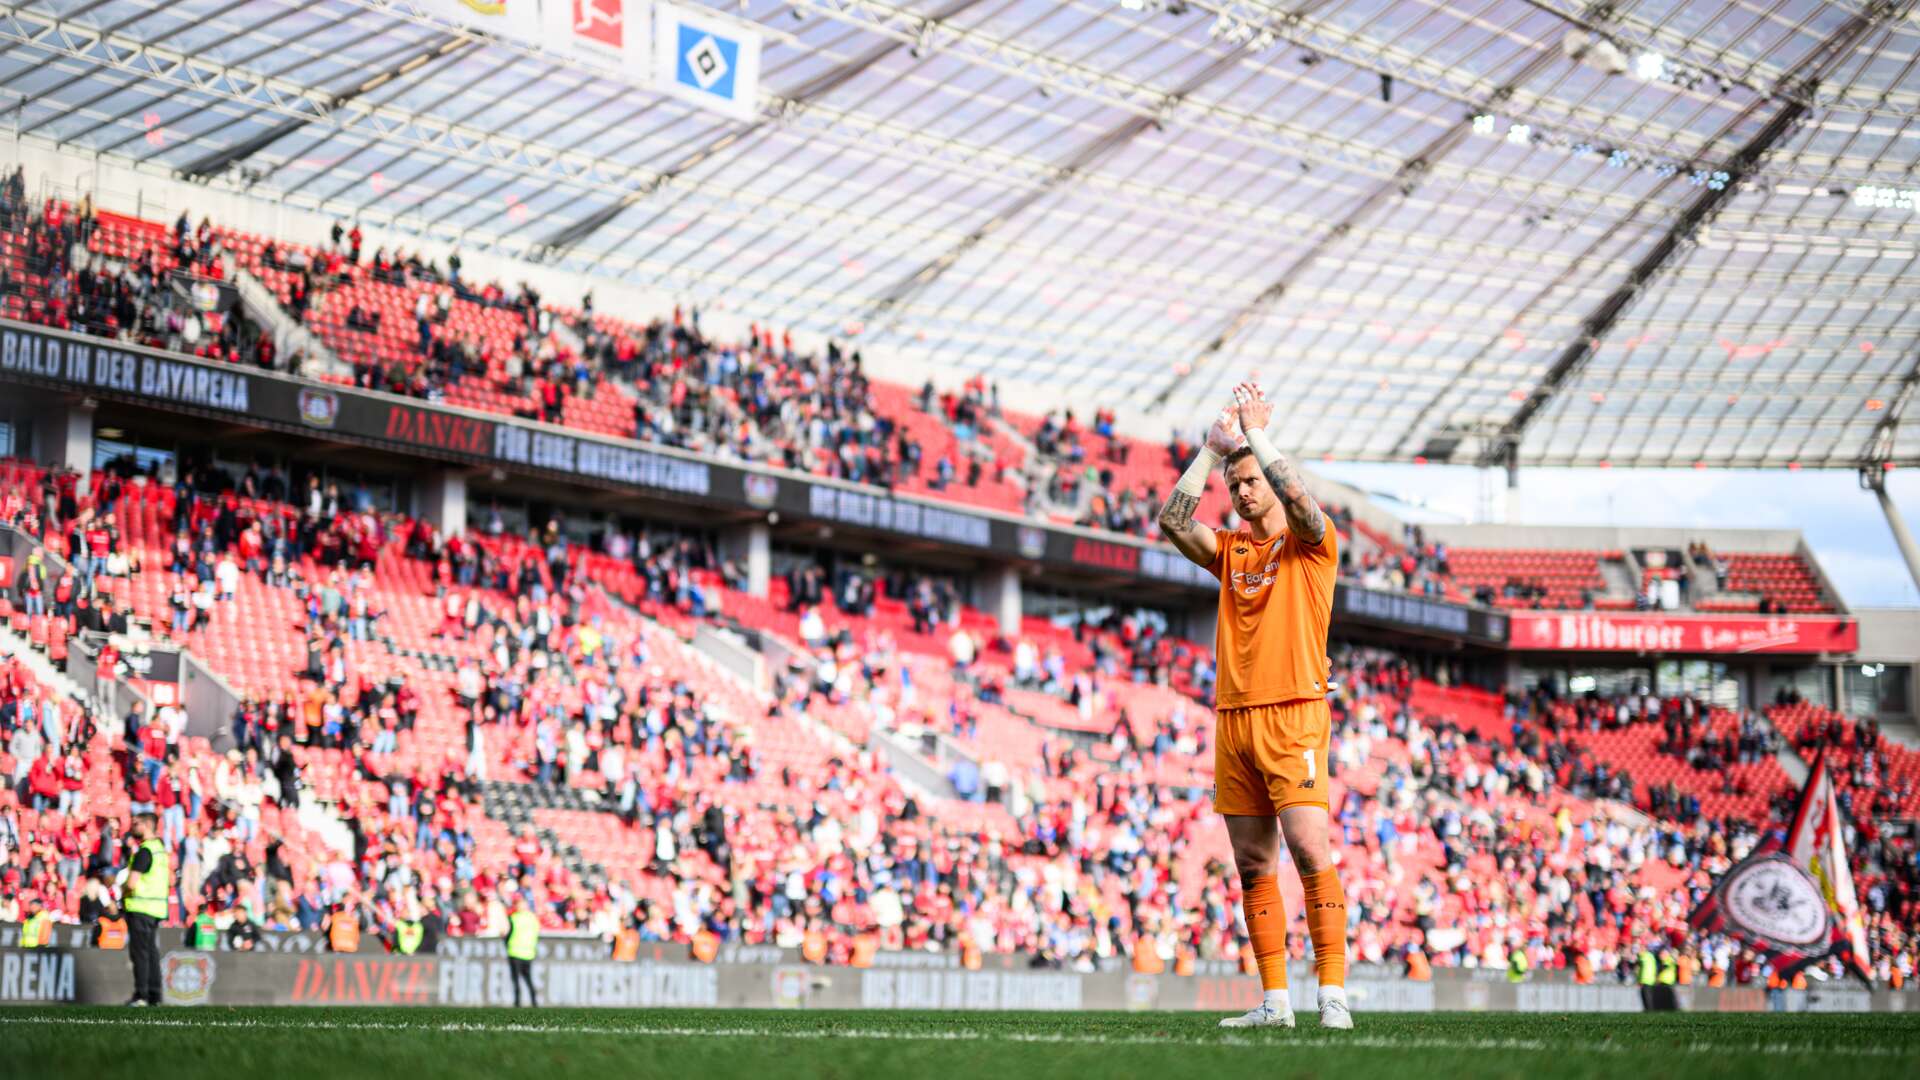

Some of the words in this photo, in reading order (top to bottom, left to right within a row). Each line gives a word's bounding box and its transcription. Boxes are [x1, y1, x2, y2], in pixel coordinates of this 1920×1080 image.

[3, 330, 62, 378] BALD
[66, 343, 90, 383] IN
[95, 349, 136, 392] DER
[141, 356, 249, 412] BAYARENA
[384, 405, 493, 455] DANKE
[1560, 614, 1685, 651] Bitburger
[1303, 749, 1316, 779] 1
[290, 958, 436, 1004] DANKE
